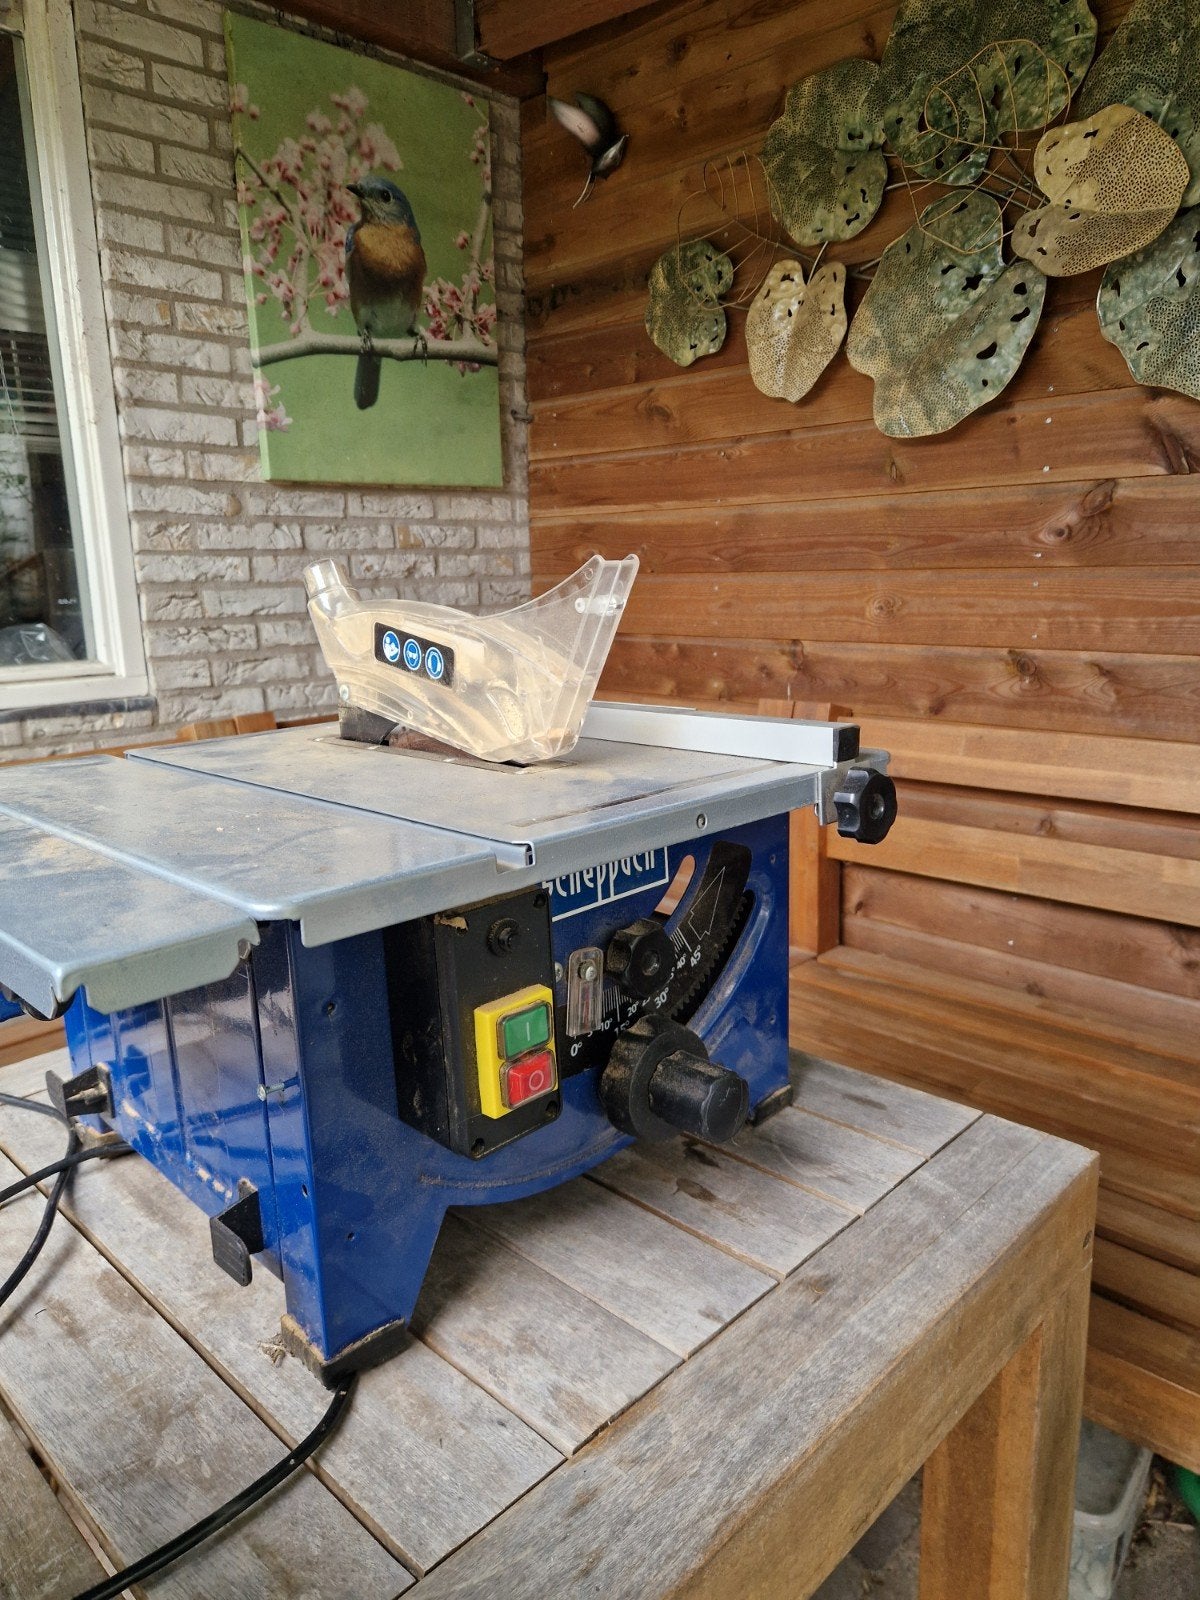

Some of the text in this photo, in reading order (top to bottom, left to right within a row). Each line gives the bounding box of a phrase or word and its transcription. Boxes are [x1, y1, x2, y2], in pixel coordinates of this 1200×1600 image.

[676, 952, 686, 970] 40°
[690, 944, 701, 967] 45°
[654, 986, 669, 1009] 30°
[627, 1000, 640, 1018] 20°
[600, 1017, 613, 1032] 10°
[570, 1041, 583, 1057] 0°
